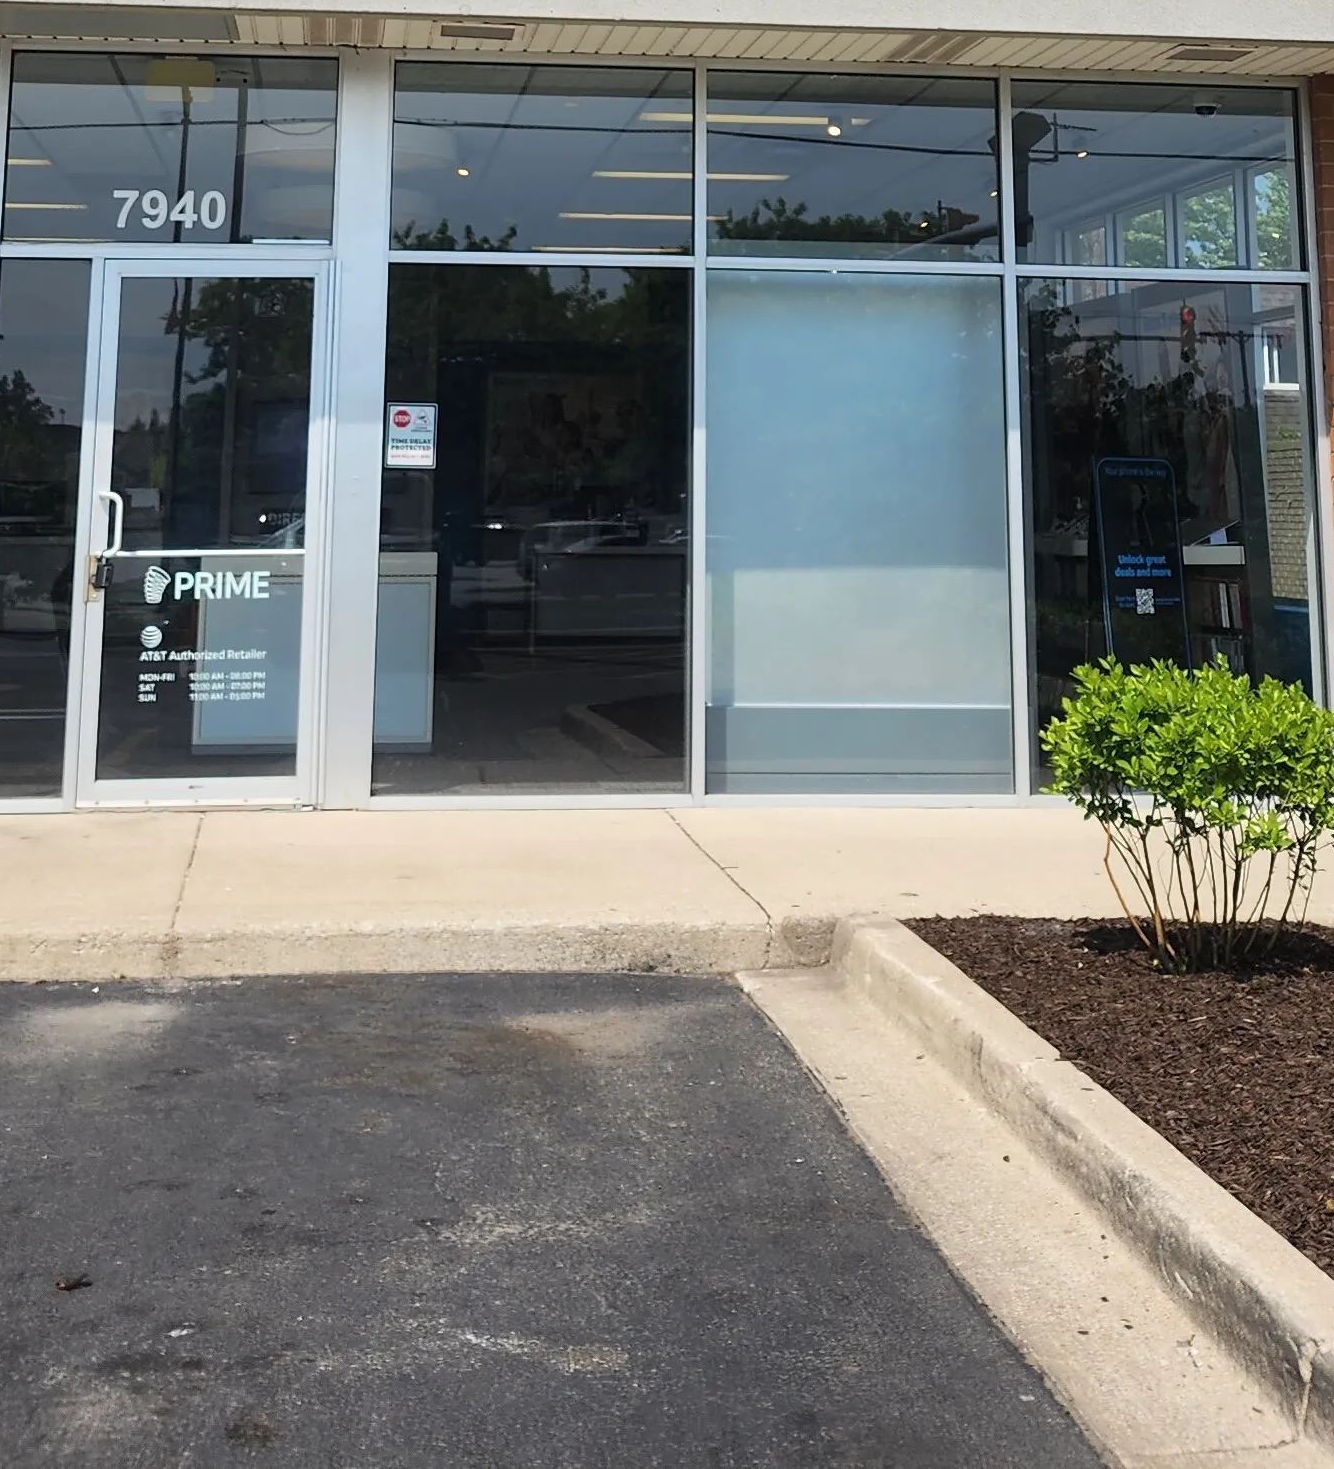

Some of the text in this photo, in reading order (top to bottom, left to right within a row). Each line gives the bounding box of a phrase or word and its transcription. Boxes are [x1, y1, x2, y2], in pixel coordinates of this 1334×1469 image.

[113, 189, 227, 230] 7940
[394, 414, 411, 424] STOP
[1118, 554, 1145, 564] Unlock
[173, 570, 271, 600] PRIME
[138, 648, 267, 662] AT&T Authorized Retailer
[139, 672, 175, 682] MON-FRI
[211, 672, 224, 681] AM
[253, 671, 266, 680] PM
[138, 683, 155, 692] SAT
[211, 682, 225, 691] AM
[253, 681, 266, 689] PM
[137, 693, 157, 702] SUN
[210, 692, 224, 700] AM
[253, 692, 266, 700] PM
